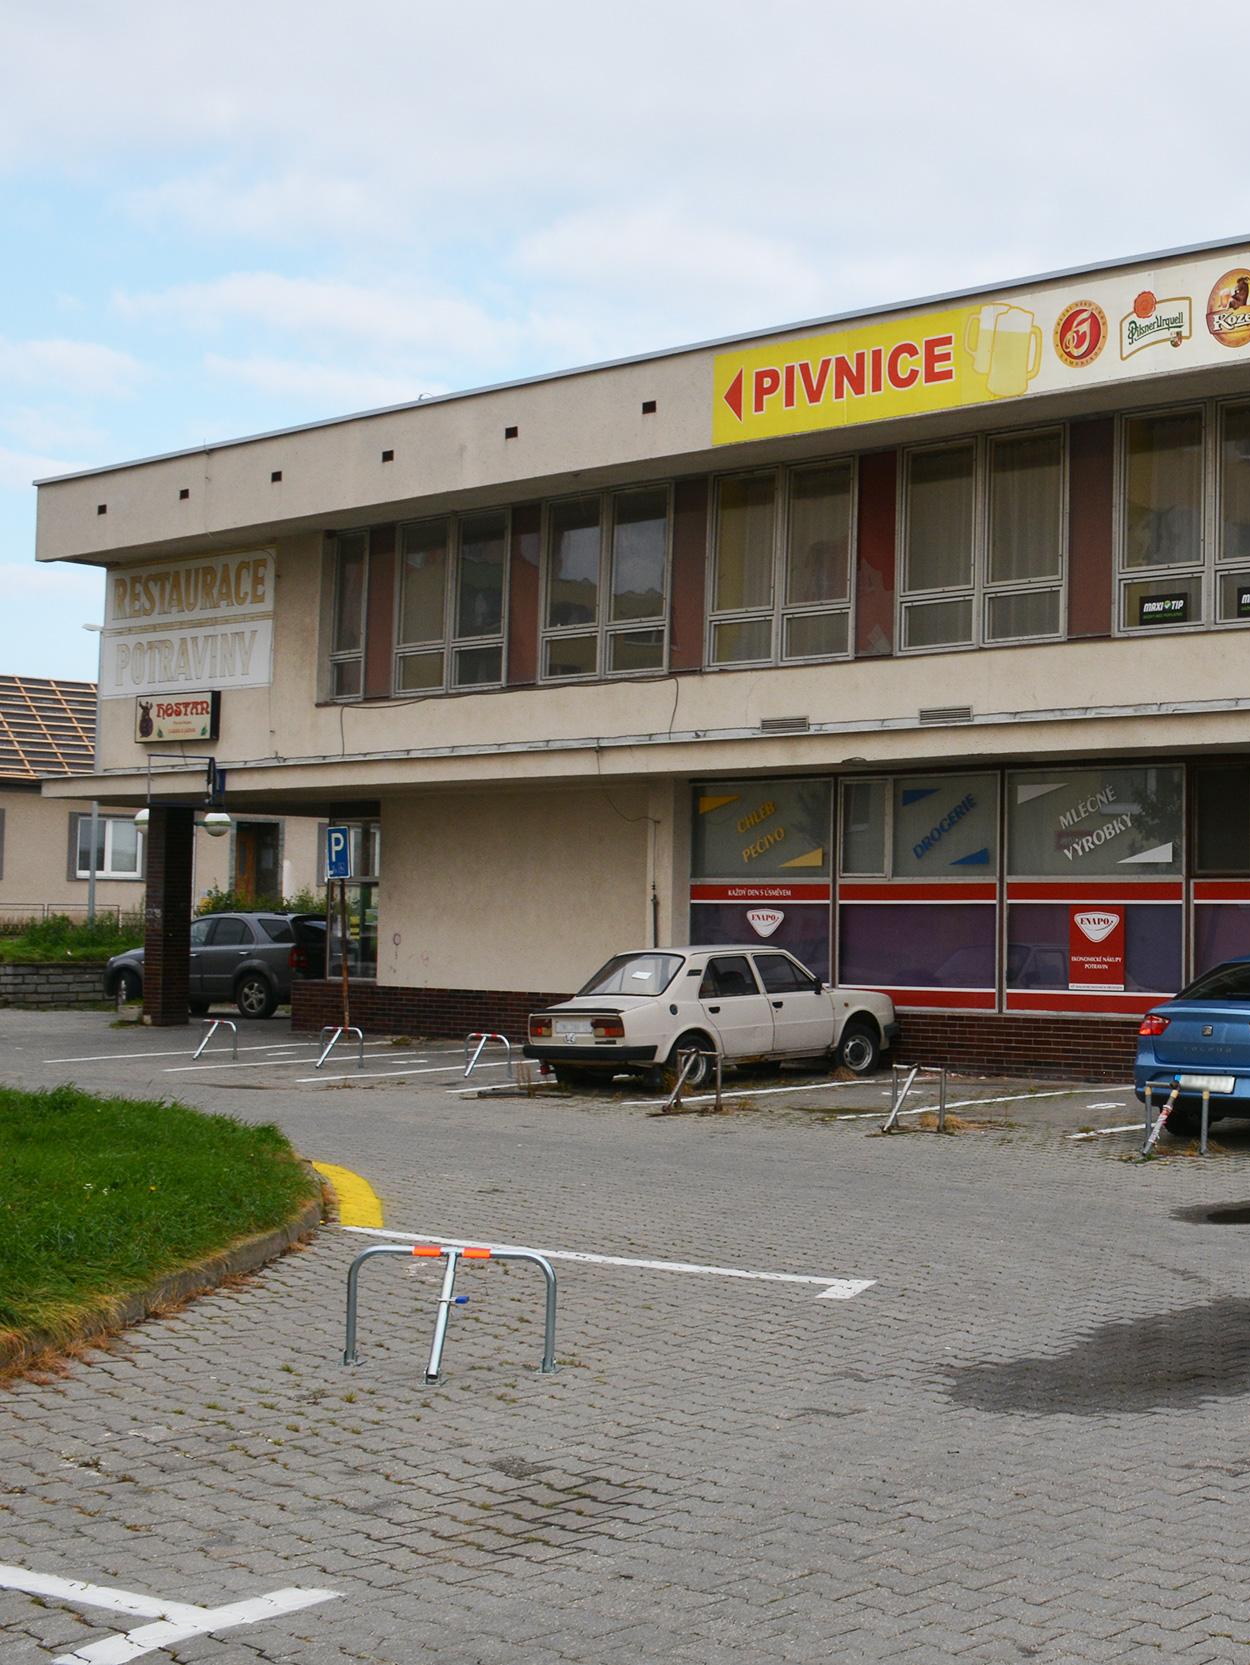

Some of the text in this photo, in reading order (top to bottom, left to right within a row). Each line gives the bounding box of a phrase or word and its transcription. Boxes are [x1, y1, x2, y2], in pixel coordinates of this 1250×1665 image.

[1128, 311, 1184, 345] Pilsner Urquell
[753, 333, 955, 413] PIVNICE
[112, 558, 268, 621] RESTAURACE
[1143, 600, 1184, 612] MAXI TIP
[114, 629, 258, 687] POTRAVINY
[331, 832, 345, 863] P
[747, 888, 759, 896] DEN
[751, 913, 776, 922] ENAPO
[1080, 917, 1109, 925] ENAPO
